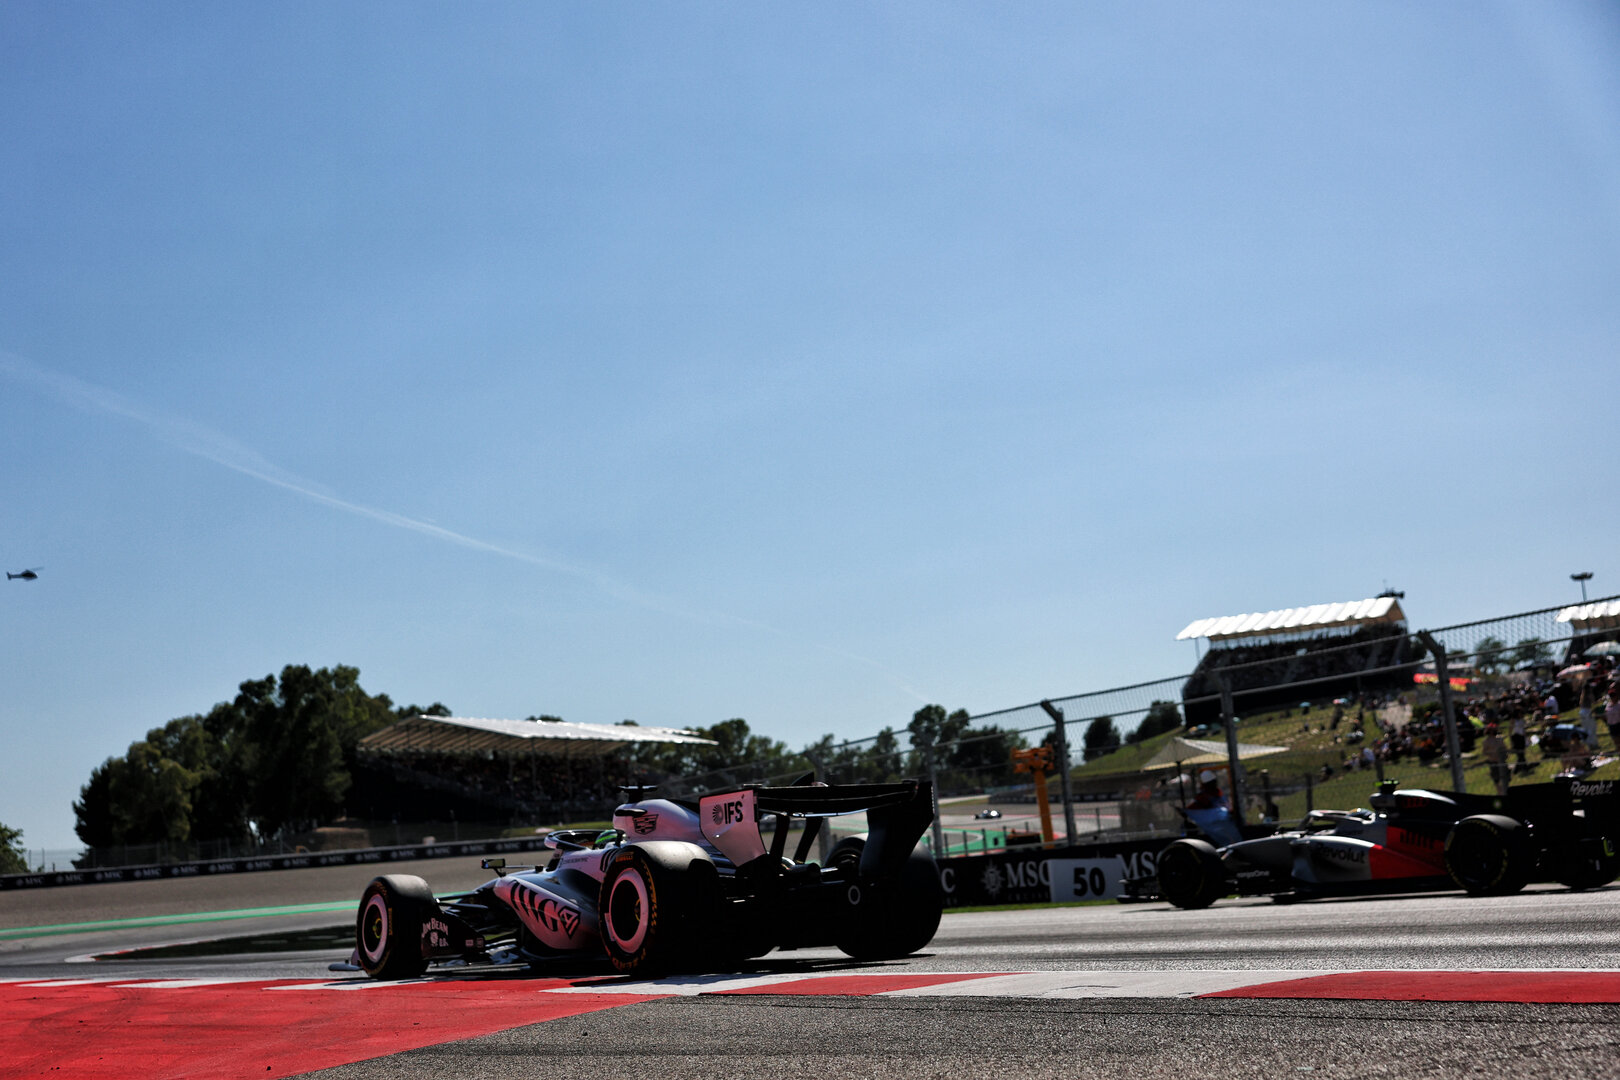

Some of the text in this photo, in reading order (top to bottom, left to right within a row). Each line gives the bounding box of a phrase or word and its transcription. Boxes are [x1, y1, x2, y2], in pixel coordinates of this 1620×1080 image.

[1570, 780, 1613, 796] Revolut
[724, 801, 743, 824] IFS
[1074, 867, 1105, 896] 50
[430, 917, 449, 936] BEAM
